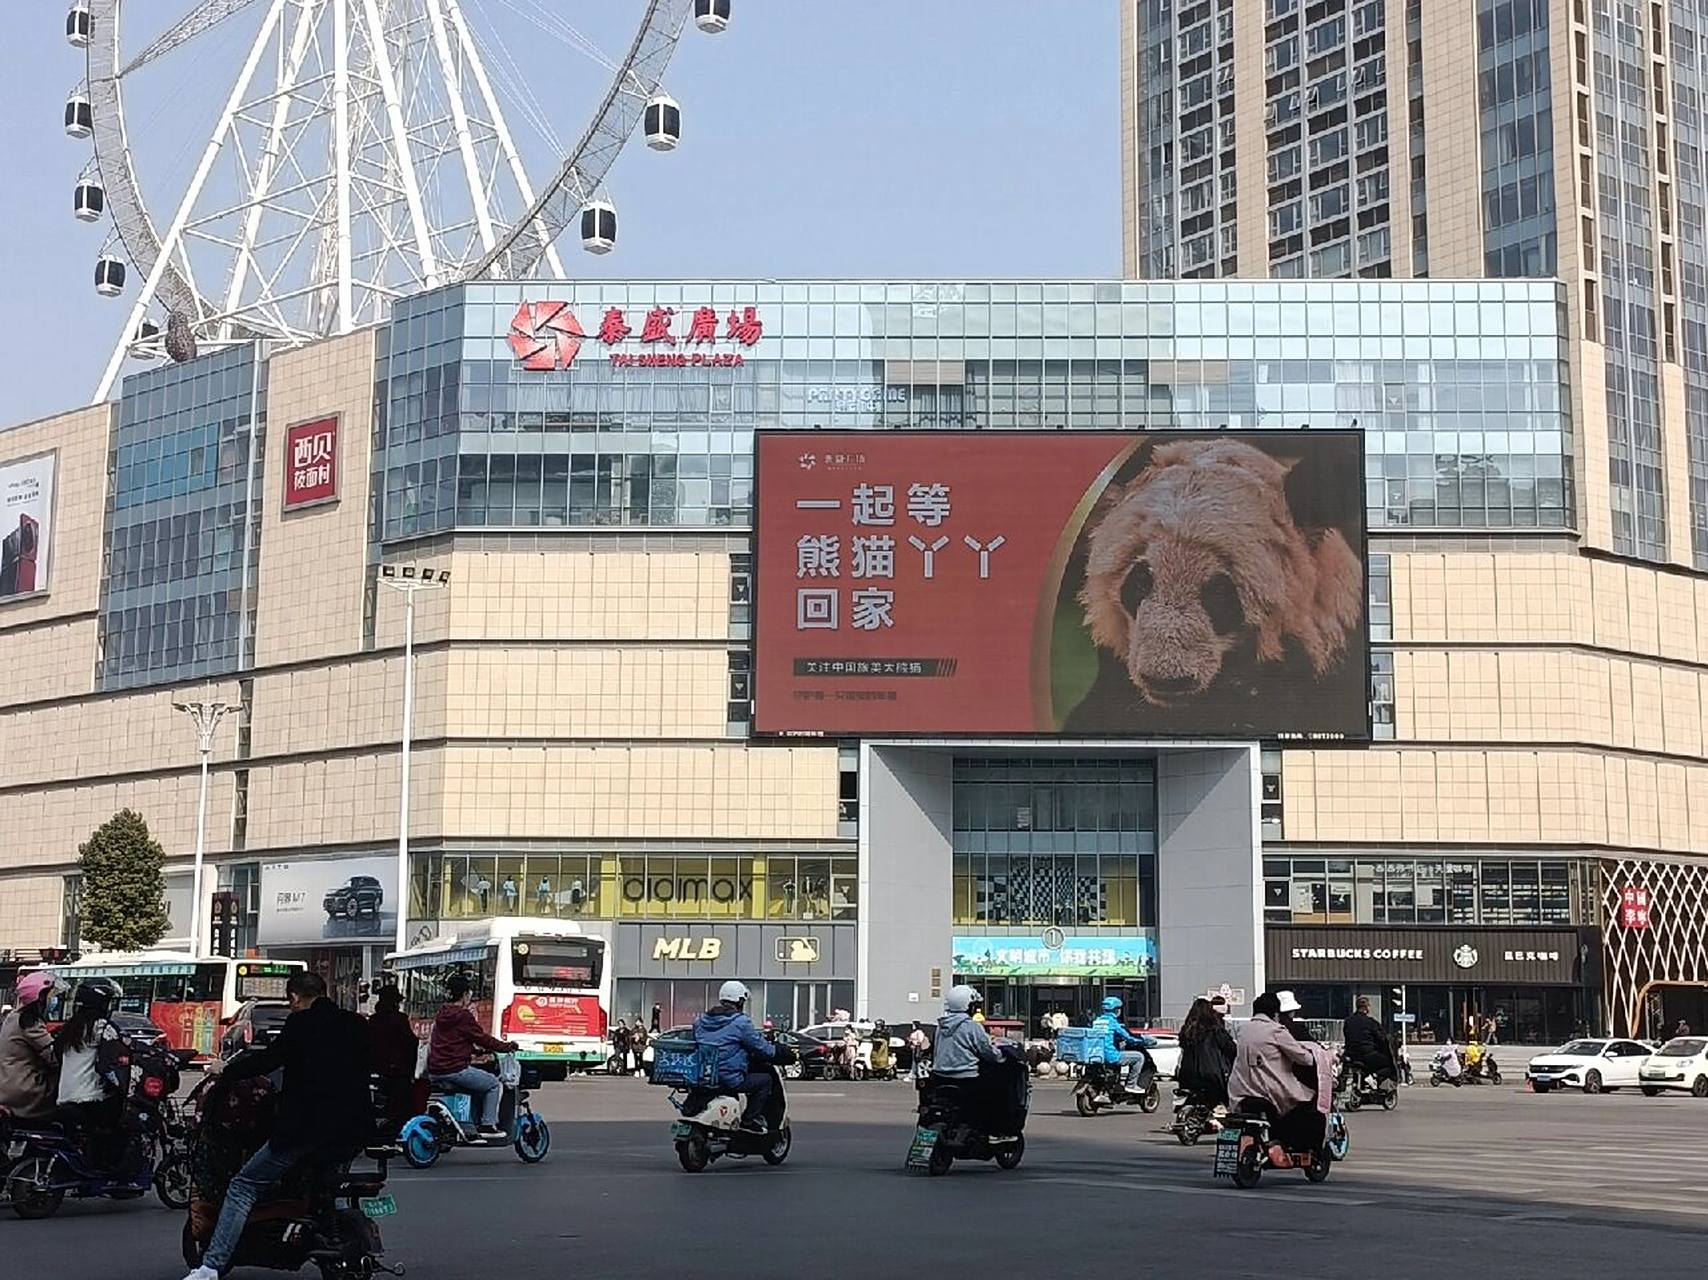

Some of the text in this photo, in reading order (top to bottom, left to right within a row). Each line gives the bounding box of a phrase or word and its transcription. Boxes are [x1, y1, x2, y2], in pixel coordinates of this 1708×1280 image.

[597, 305, 763, 346] 泰盛廣場
[638, 353, 686, 367] SHENG
[692, 353, 744, 367] PLAZA
[294, 432, 332, 468] 西贝
[294, 463, 330, 491] 莜面村
[796, 483, 951, 526] 一起等
[796, 535, 1006, 578] 熊猫丫丫
[796, 587, 895, 631] 回家
[652, 937, 721, 960] MLB
[1292, 948, 1423, 960] STARBUCKS COFFEE
